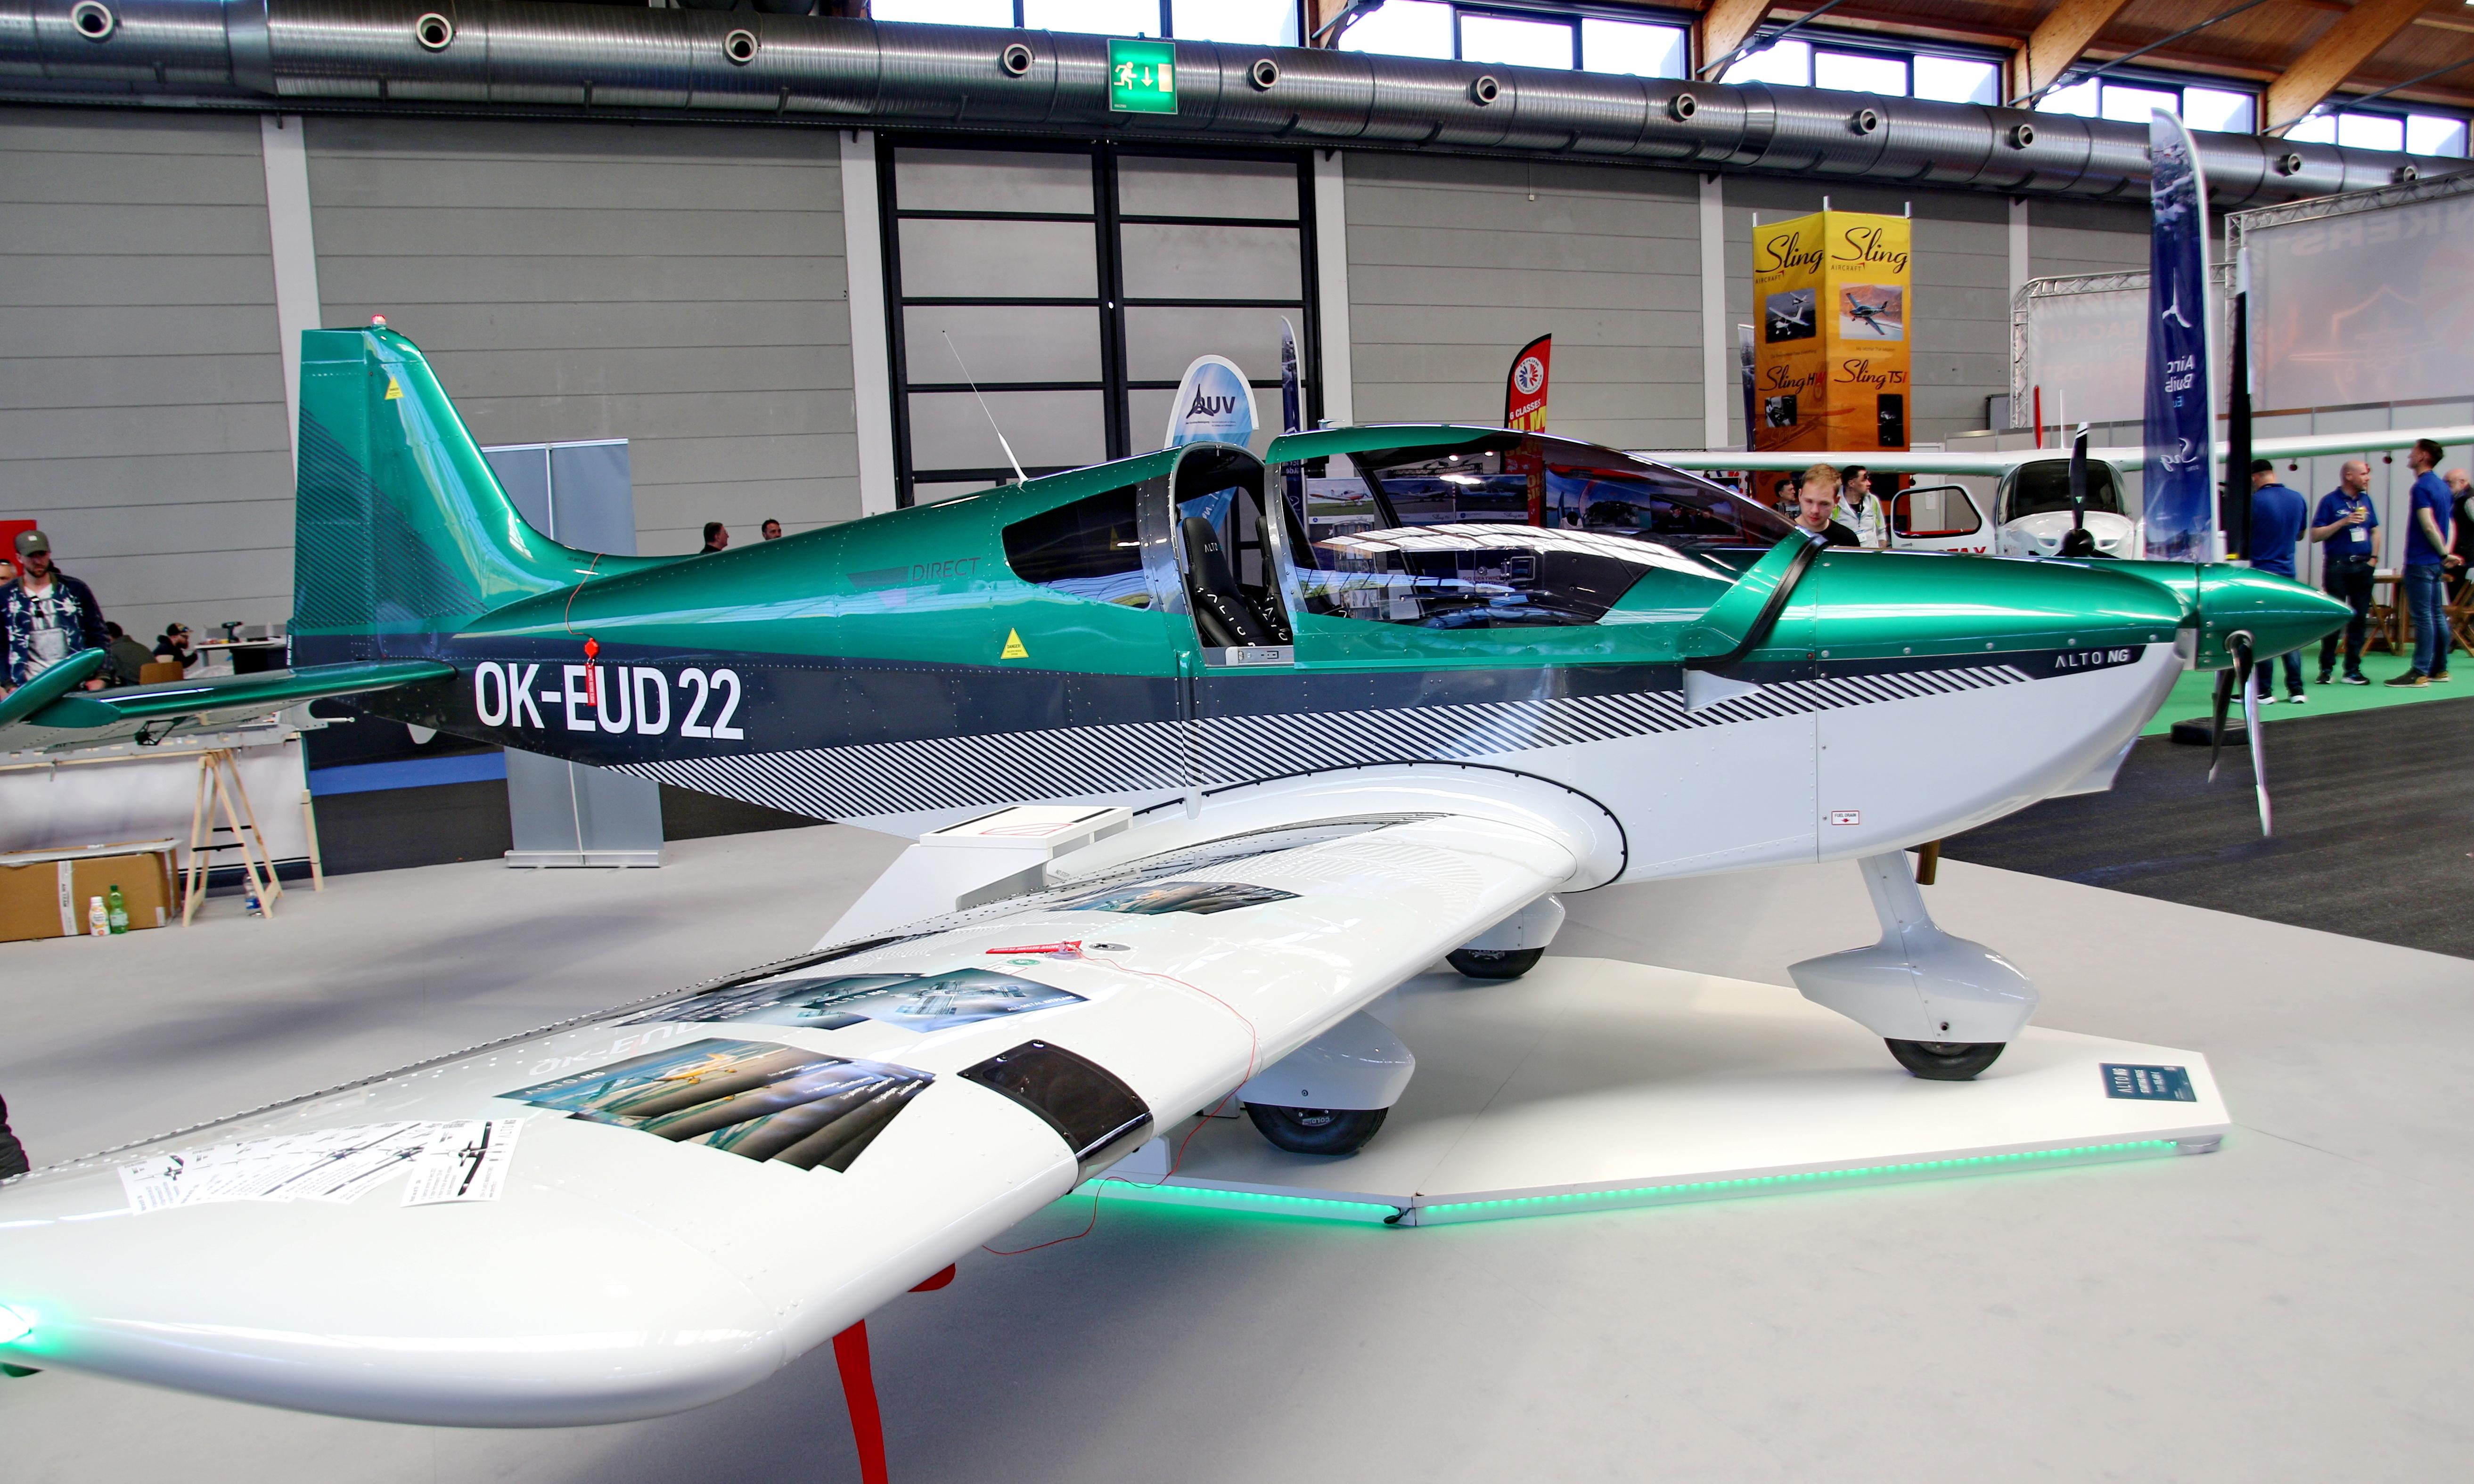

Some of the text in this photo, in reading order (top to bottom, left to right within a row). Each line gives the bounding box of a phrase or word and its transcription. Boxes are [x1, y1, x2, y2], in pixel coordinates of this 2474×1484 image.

[1755, 232, 1823, 274] Sling
[1831, 227, 1908, 274] Sling
[1755, 275, 1781, 284] AIRCRAFT
[1759, 365, 1807, 394] Sling
[1834, 359, 1908, 390] Sling TSi
[1509, 399, 1541, 420] 6 CLASSES
[912, 557, 981, 581] DIRECT
[2055, 649, 2130, 668] ALTO NG
[475, 661, 671, 735] OK-EUD
[678, 668, 745, 741] 22
